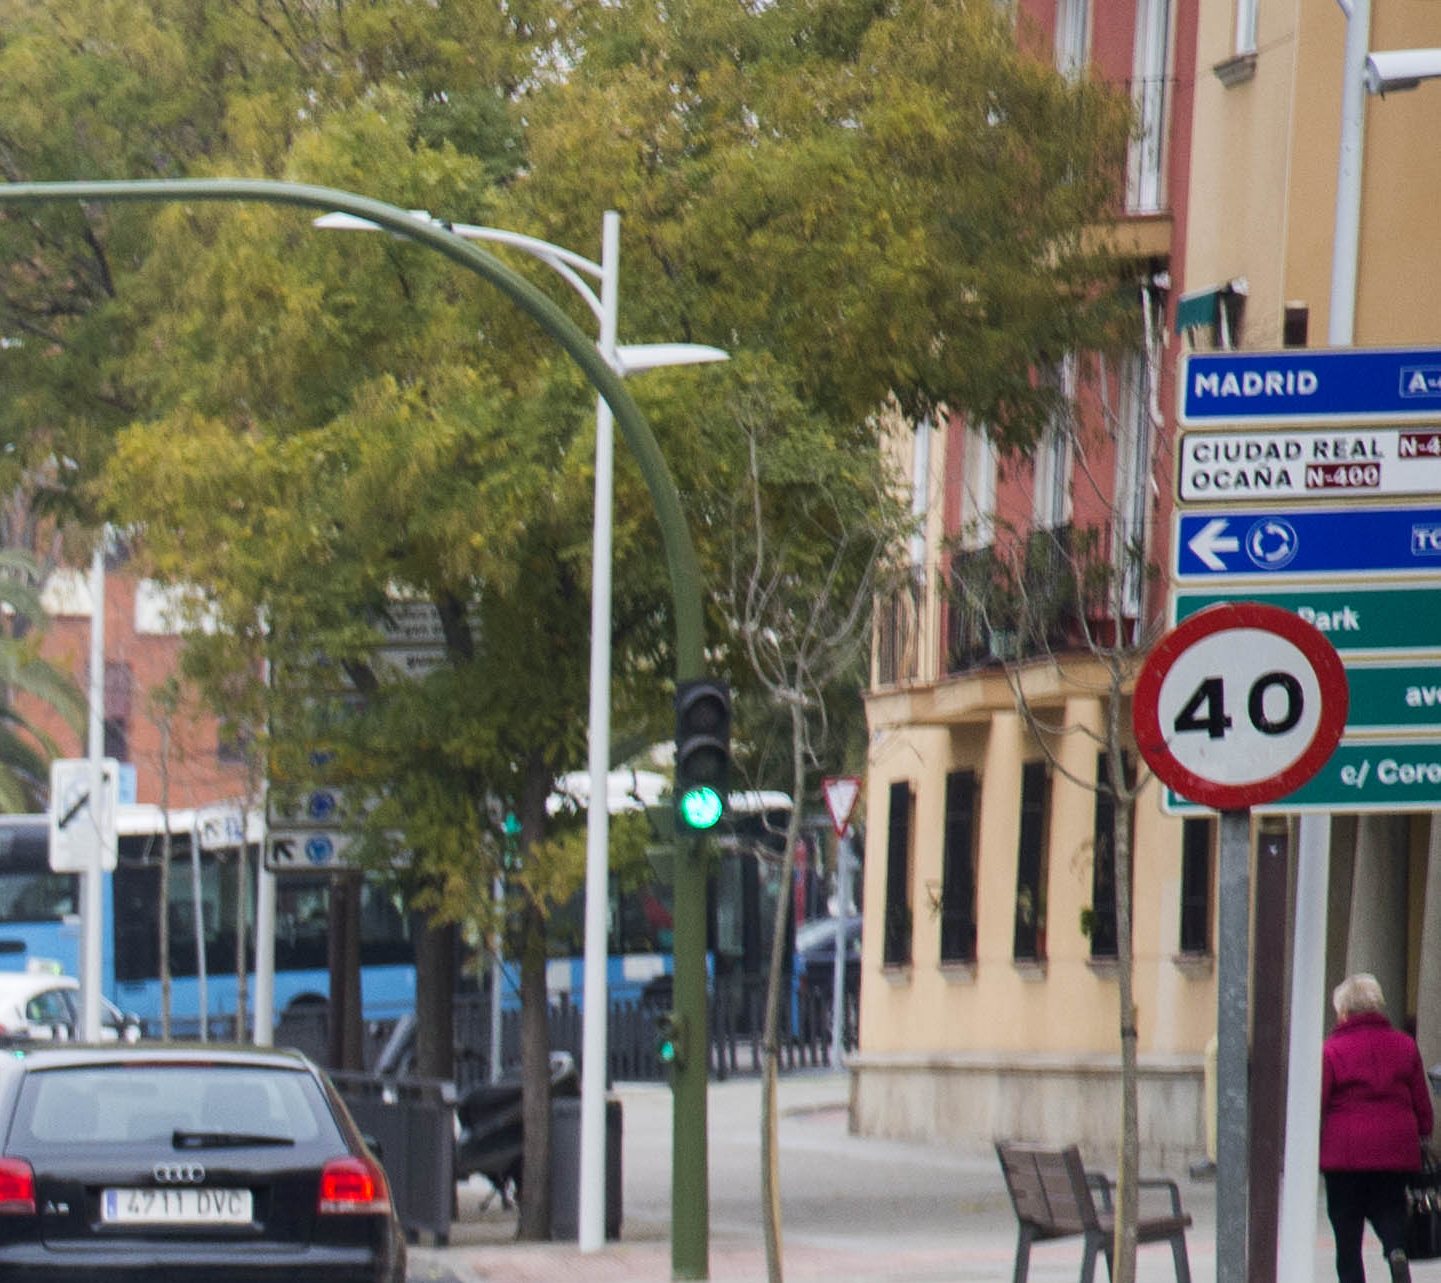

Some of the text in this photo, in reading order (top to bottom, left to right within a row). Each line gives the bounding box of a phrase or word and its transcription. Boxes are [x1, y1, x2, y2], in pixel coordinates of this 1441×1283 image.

[1194, 370, 1318, 398] MADRID
[1192, 440, 1302, 464] CIUDAD
[1313, 437, 1384, 460] REAL
[1192, 463, 1379, 490] OCAÑA N-400
[1174, 671, 1304, 740] 40
[196, 1189, 243, 1216] DVC
